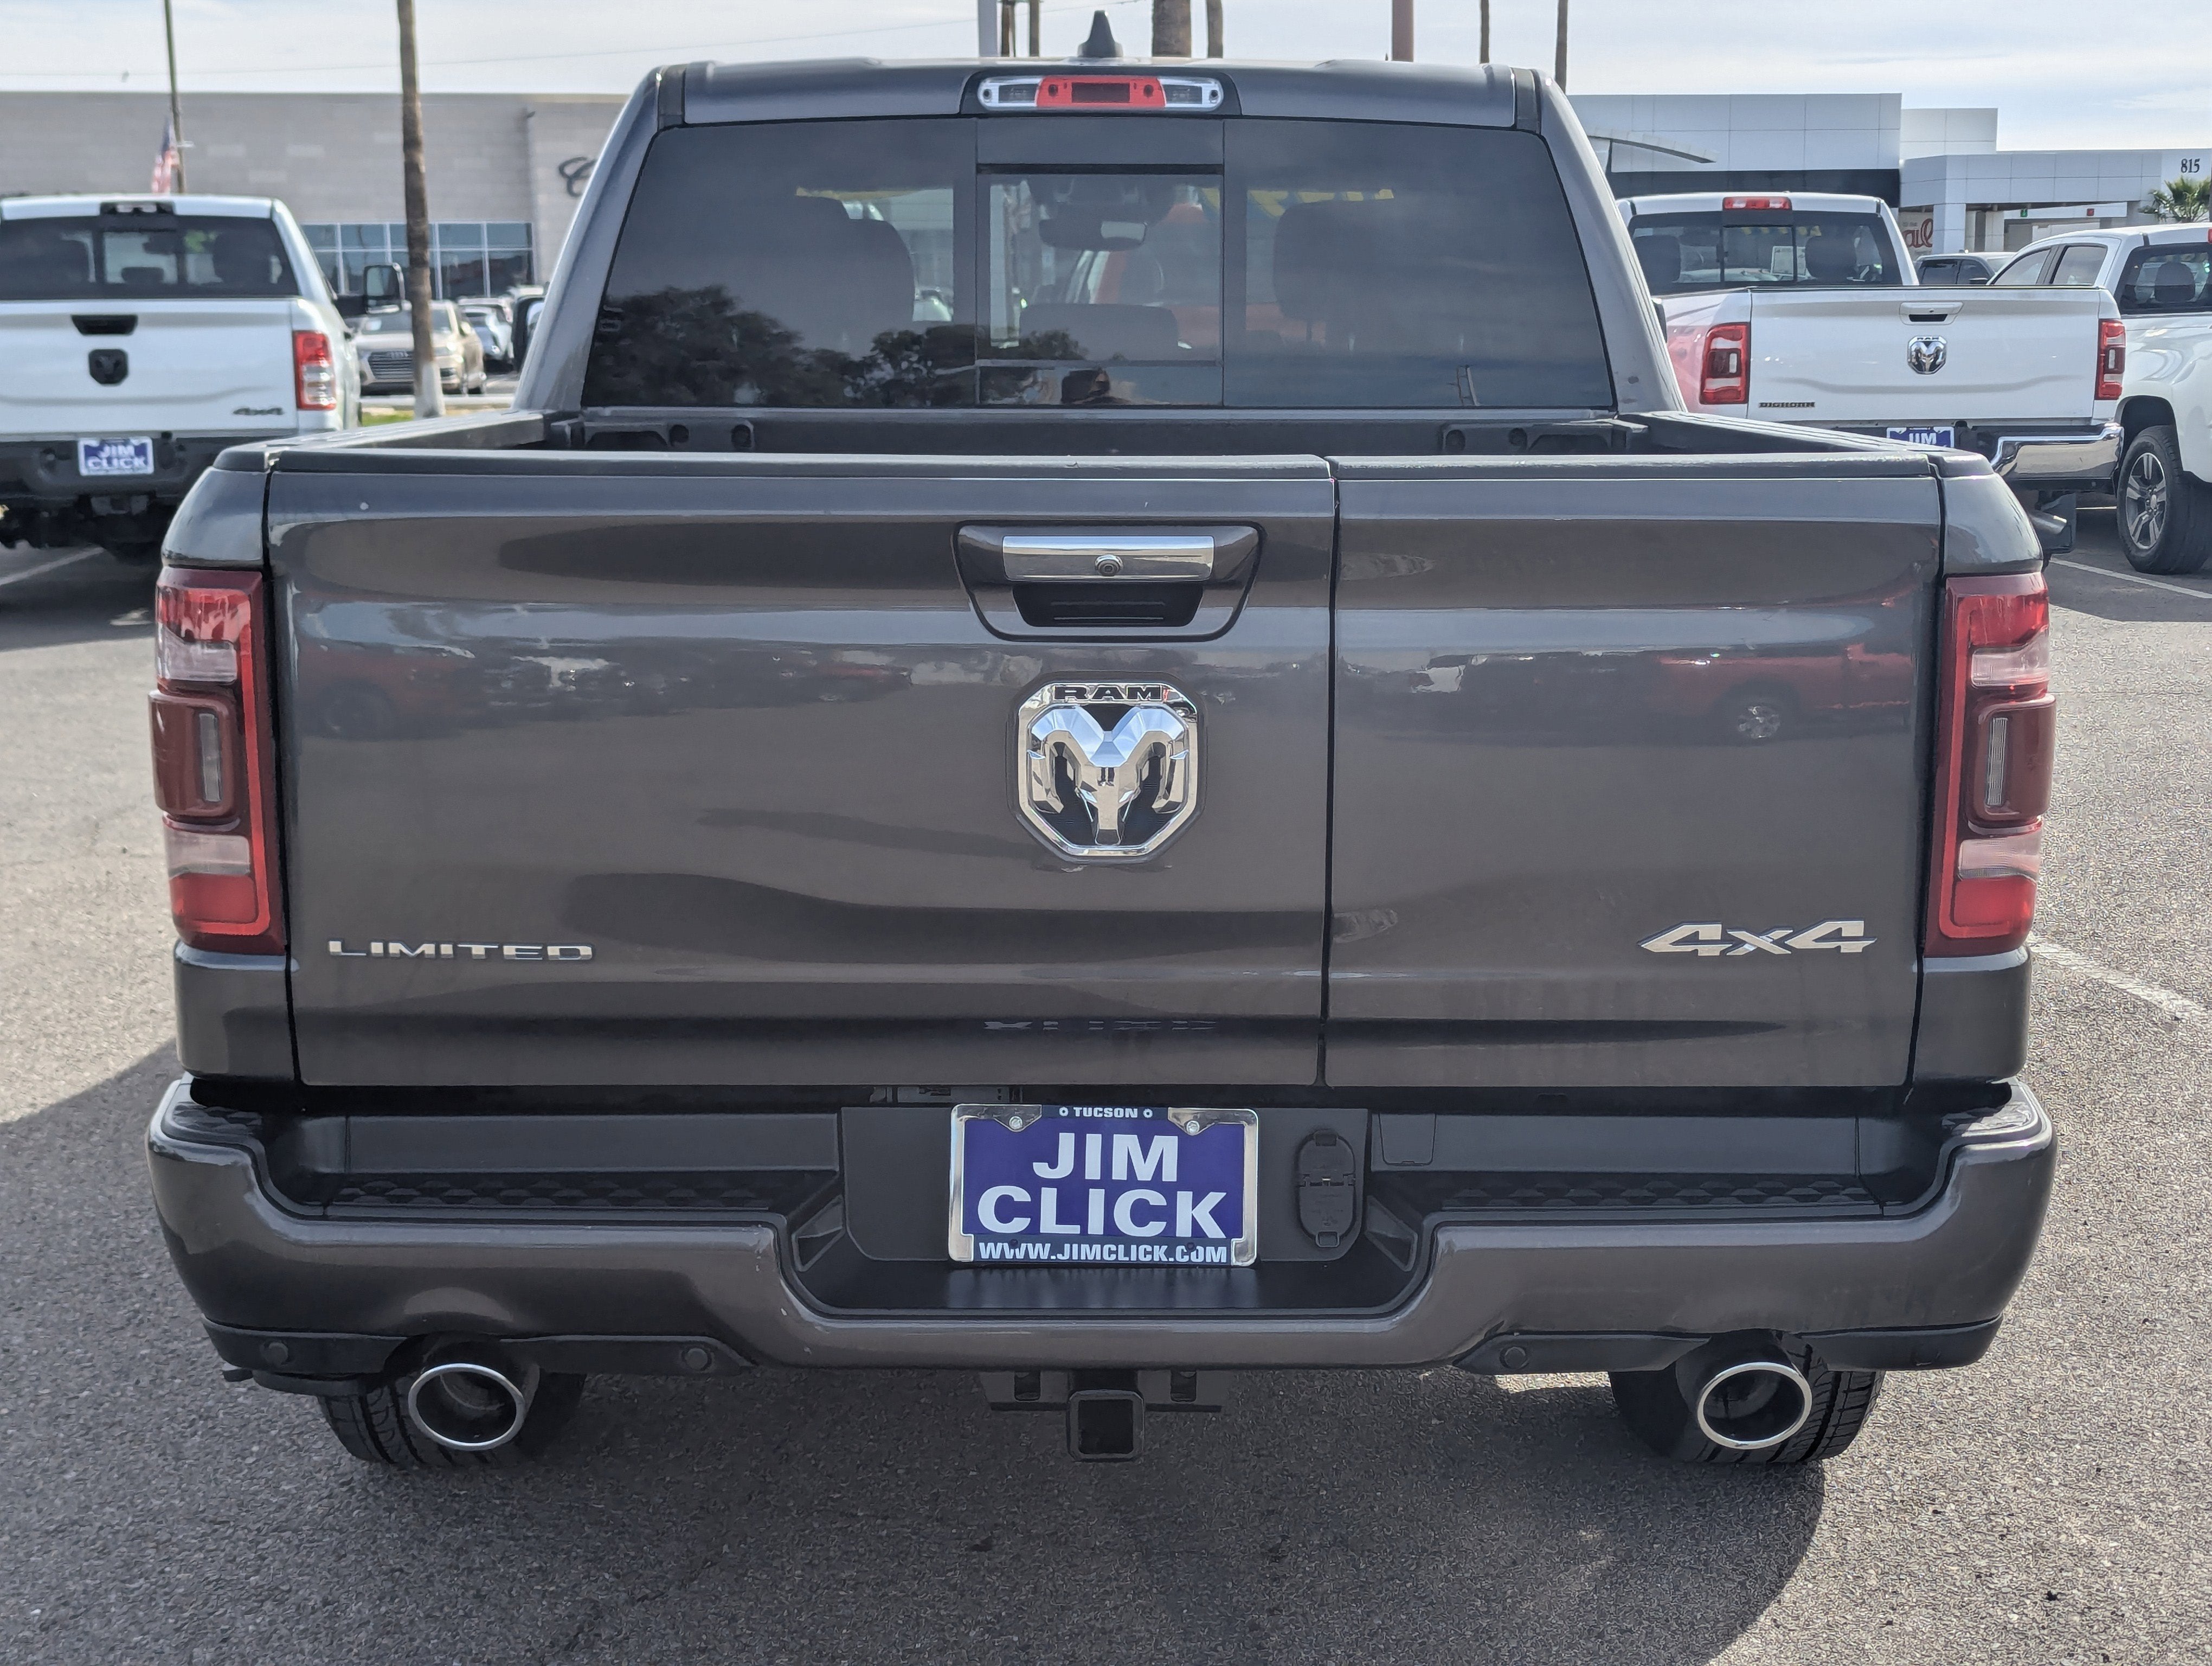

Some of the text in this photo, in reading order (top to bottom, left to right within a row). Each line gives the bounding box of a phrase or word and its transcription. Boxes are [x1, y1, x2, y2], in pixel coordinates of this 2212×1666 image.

[2181, 158, 2200, 173] 815
[98, 445, 135, 457] JIM
[88, 456, 147, 469] CLICK
[1054, 685, 1161, 700] RAM
[329, 940, 593, 960] LIMITED
[1073, 1107, 1138, 1118] TUCSON
[1033, 1133, 1178, 1182] JIM
[978, 1186, 1227, 1238] CLICK
[979, 1242, 1227, 1263] WWW.JIMCLICK.COM
